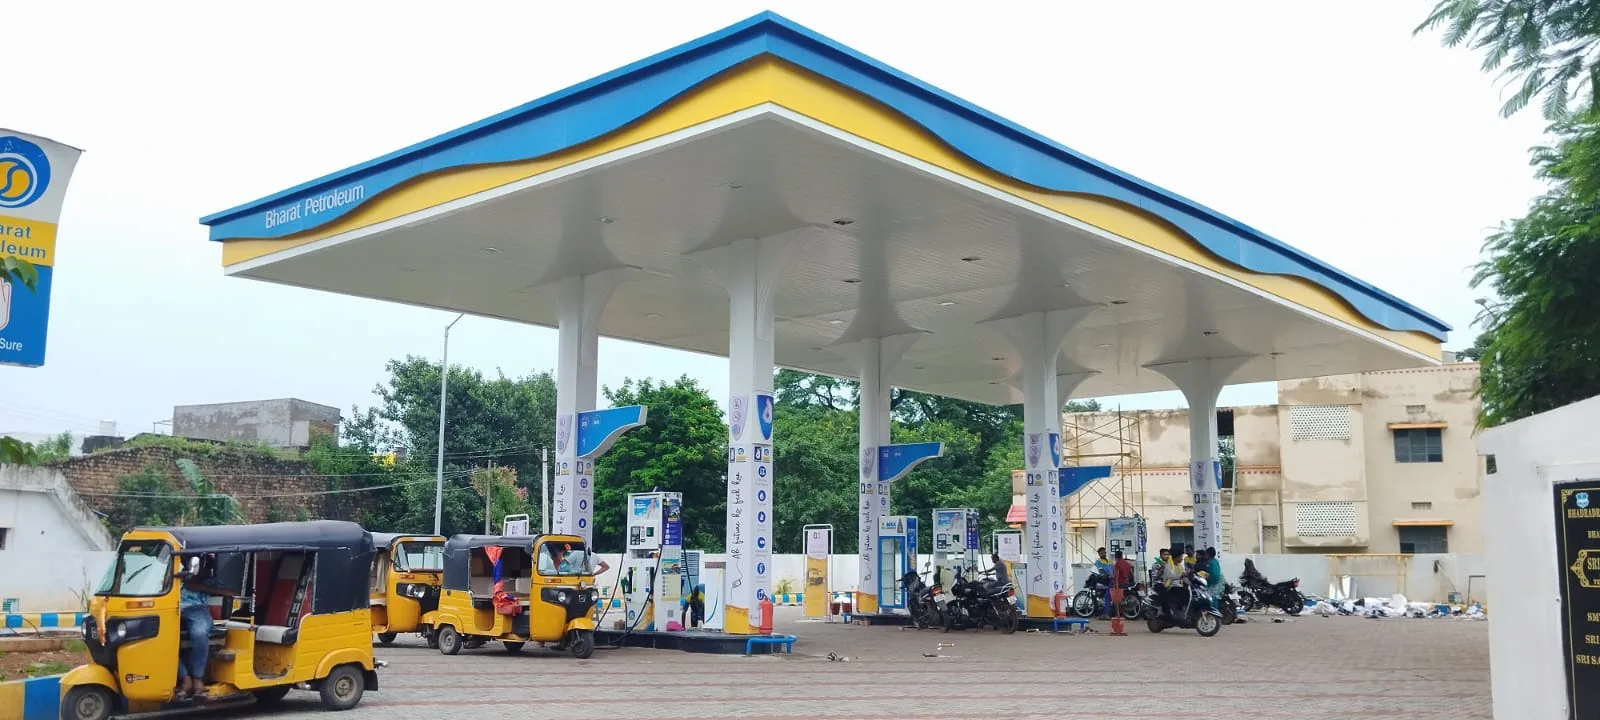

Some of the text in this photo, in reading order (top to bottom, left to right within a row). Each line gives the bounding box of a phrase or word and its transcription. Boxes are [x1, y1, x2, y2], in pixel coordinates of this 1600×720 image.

[265, 184, 364, 229] Bharat Petroleum
[1, 239, 46, 259] leum
[0, 337, 23, 351] Sure
